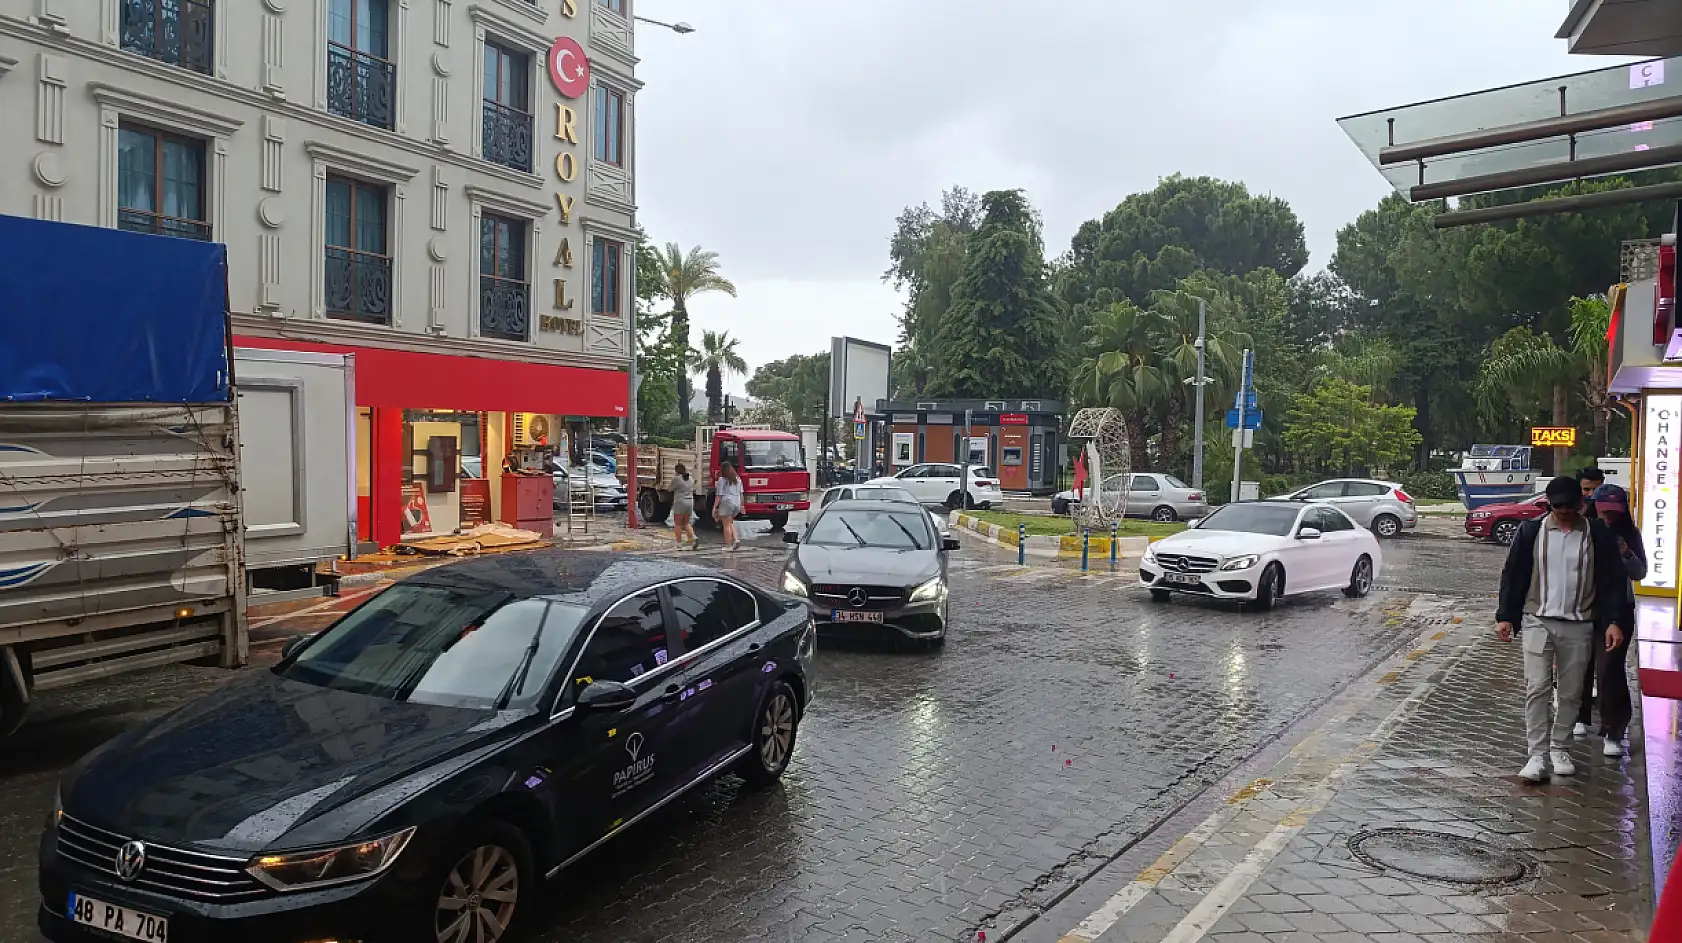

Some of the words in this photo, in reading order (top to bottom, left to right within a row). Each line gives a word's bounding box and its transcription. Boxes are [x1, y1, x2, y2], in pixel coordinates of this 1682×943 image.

[553, 102, 578, 311] ROYAL
[540, 314, 585, 335] HOTEL
[1656, 409, 1670, 485] CHANGE
[1653, 498, 1667, 574] OFFICE
[75, 898, 94, 922] 48
[105, 905, 124, 931] PA
[136, 913, 166, 942] 704
